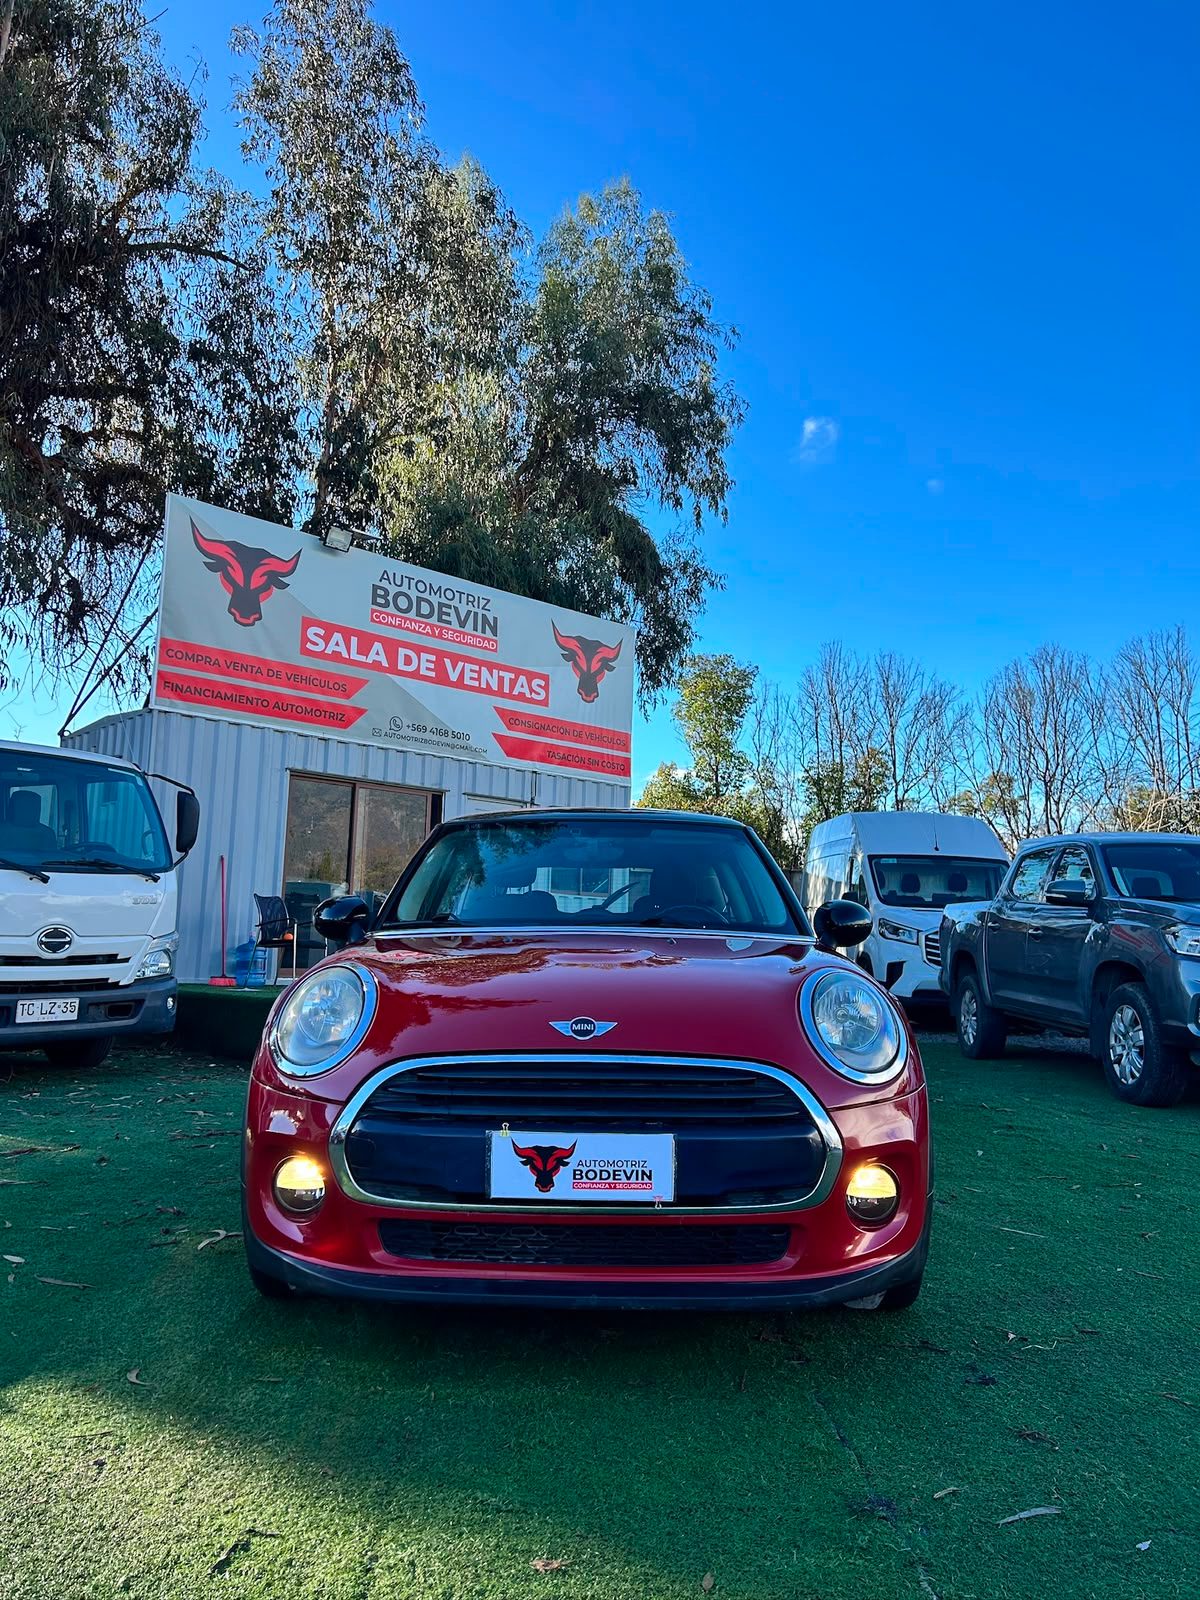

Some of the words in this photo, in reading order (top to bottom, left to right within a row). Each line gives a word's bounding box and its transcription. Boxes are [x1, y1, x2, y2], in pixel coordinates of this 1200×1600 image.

[379, 570, 491, 612] AUTOMOTRIZ
[371, 584, 498, 637] BODEVIN
[372, 612, 432, 635] CONFIANZA
[433, 624, 441, 635] Y
[442, 629, 497, 650] SEGURIDAD
[165, 648, 221, 668] COMPRA
[224, 660, 264, 676] VENTA
[267, 668, 282, 680] DE
[285, 672, 348, 693] VEHÍCULOS
[305, 626, 389, 668] SALA
[397, 647, 436, 677] DE
[443, 658, 547, 701] VENTAS
[162, 681, 270, 708] FINANCIAMIENTO
[272, 701, 346, 723] AUTOMOTRIZ
[406, 723, 428, 734] +569
[429, 727, 450, 738] 4168
[451, 730, 471, 742] 5010
[572, 729, 583, 739] DE
[587, 757, 600, 767] SIN
[601, 760, 626, 772] COSTO
[572, 1023, 594, 1031] MINI
[572, 1169, 653, 1182] BODEVIN
[576, 1159, 648, 1169] AUTOMOTRIZ
